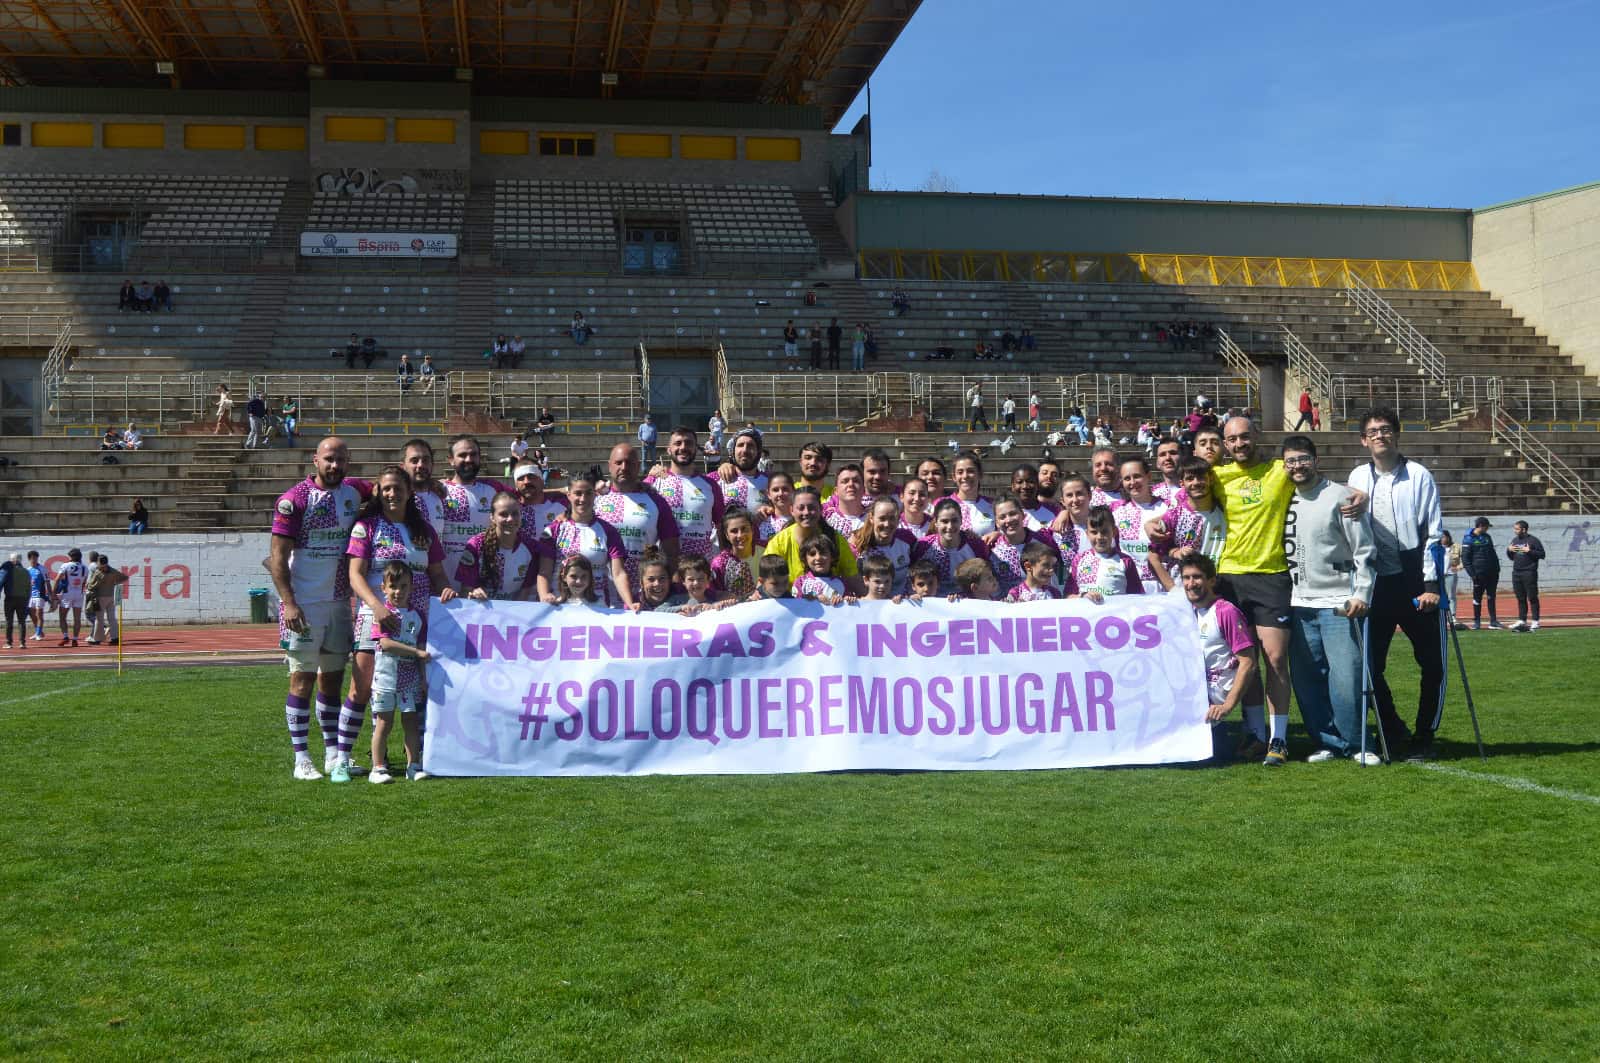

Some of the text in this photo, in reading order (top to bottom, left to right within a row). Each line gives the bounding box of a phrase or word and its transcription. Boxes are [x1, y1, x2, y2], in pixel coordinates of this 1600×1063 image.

[44, 554, 191, 600] Sria
[70, 563, 86, 577] 21
[465, 614, 1162, 660] INGENIERAS & INGENIEROS
[518, 671, 1117, 746] #SOLOQUEREMOSJUGAR
